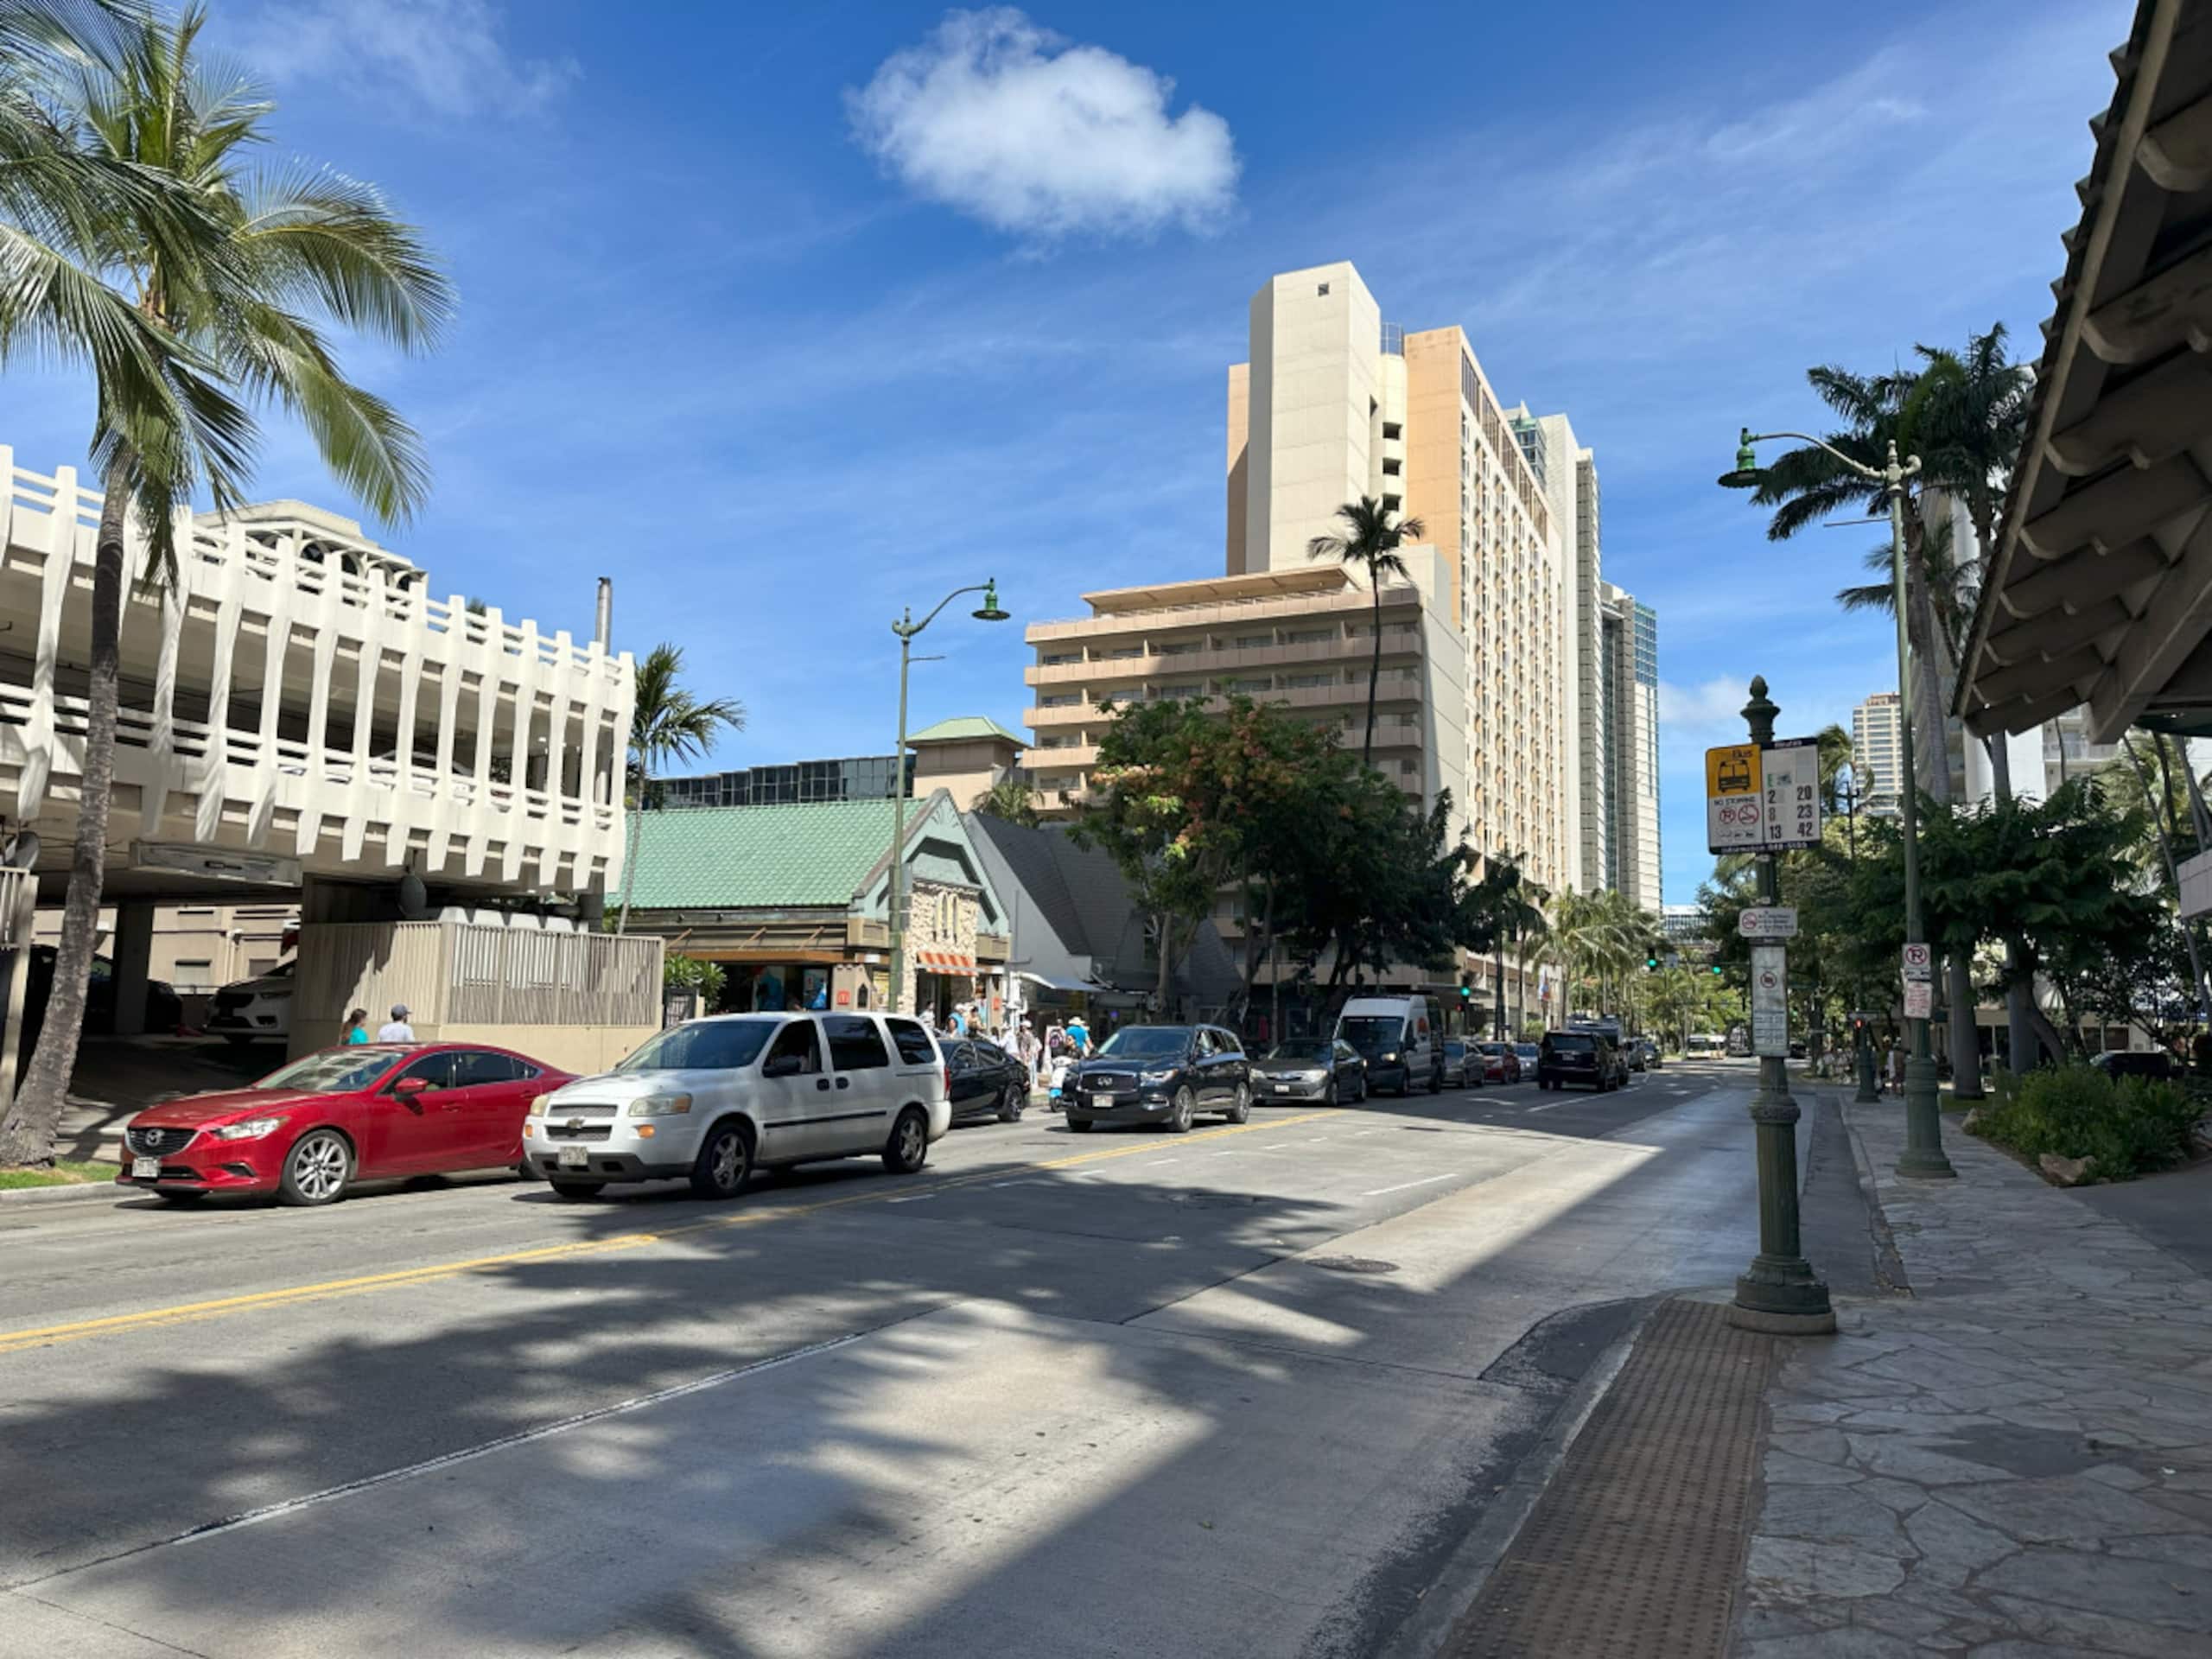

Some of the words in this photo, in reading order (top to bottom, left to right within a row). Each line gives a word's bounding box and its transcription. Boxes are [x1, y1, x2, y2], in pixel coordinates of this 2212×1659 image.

[1769, 789, 1777, 804] 2
[1797, 785, 1812, 800] 20
[1797, 804, 1812, 818] 23
[1770, 824, 1782, 840] 13
[1797, 822, 1814, 837] 42
